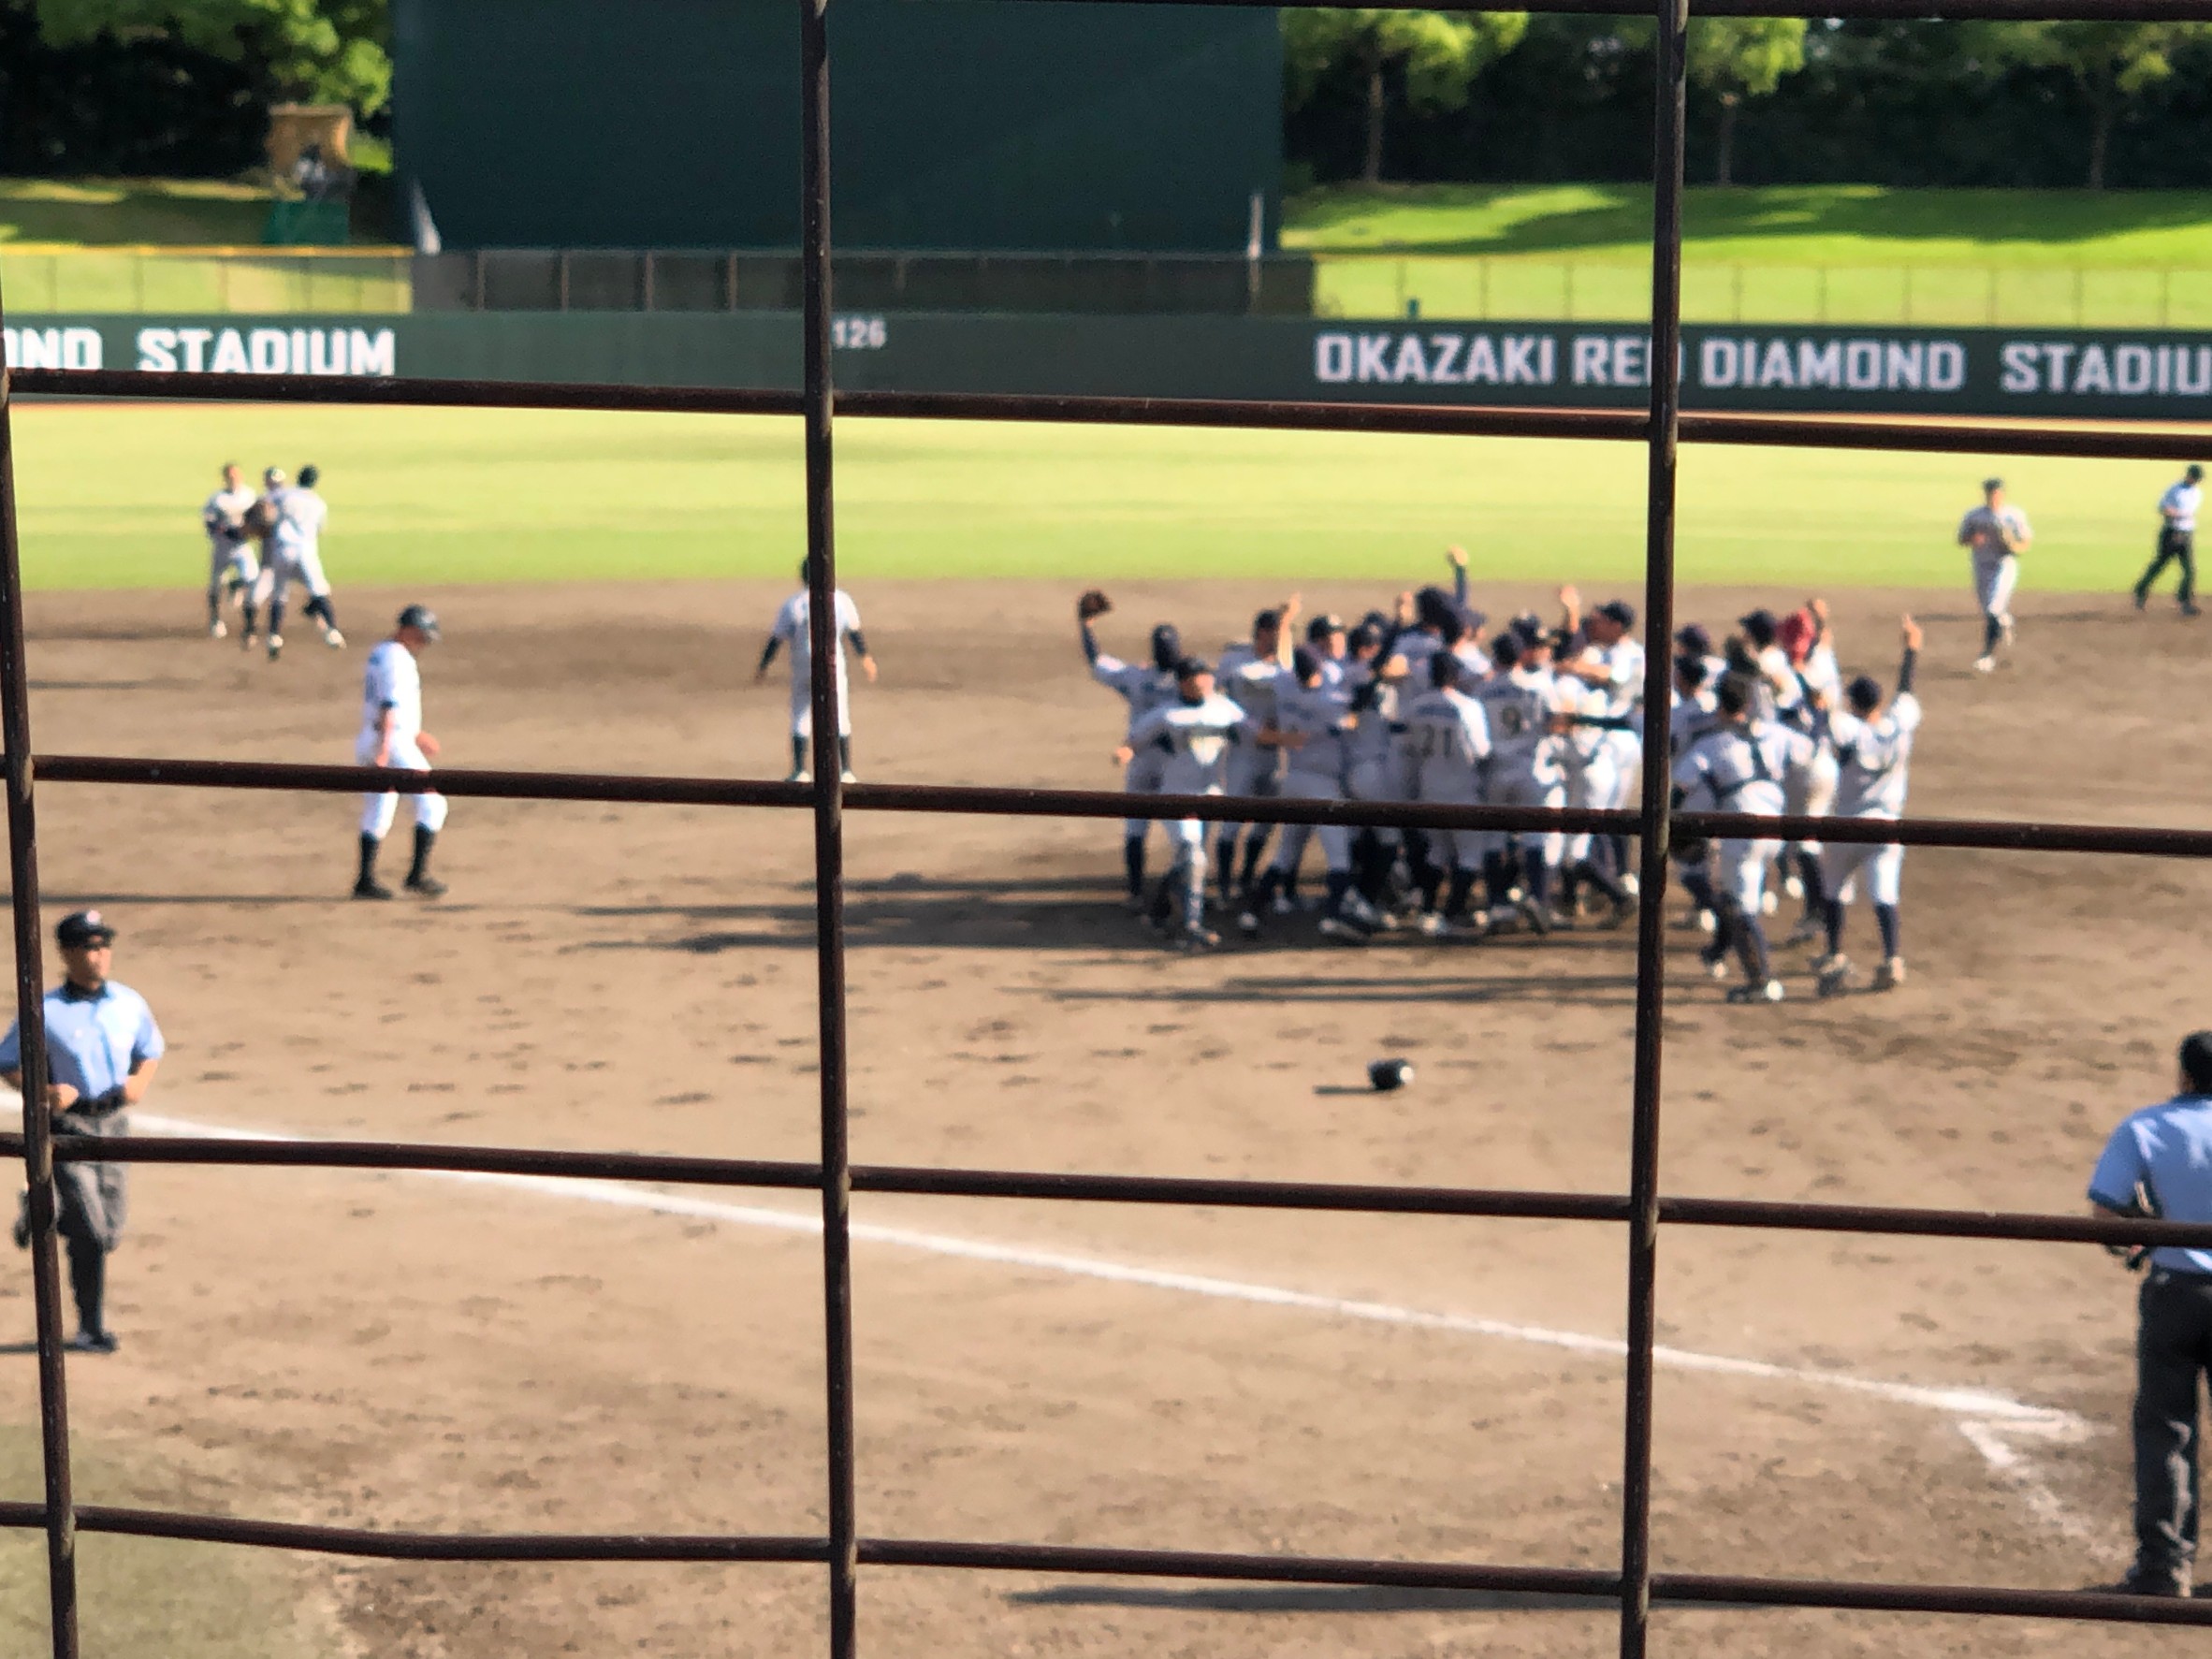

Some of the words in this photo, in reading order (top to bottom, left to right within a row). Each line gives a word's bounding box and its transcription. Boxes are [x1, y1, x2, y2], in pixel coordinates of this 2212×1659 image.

[137, 327, 395, 375] STADIUM
[834, 317, 887, 349] 126
[1315, 333, 1555, 385] OKAZAKI
[1573, 336, 1683, 387] RE
[1699, 338, 1966, 390] DIAMOND
